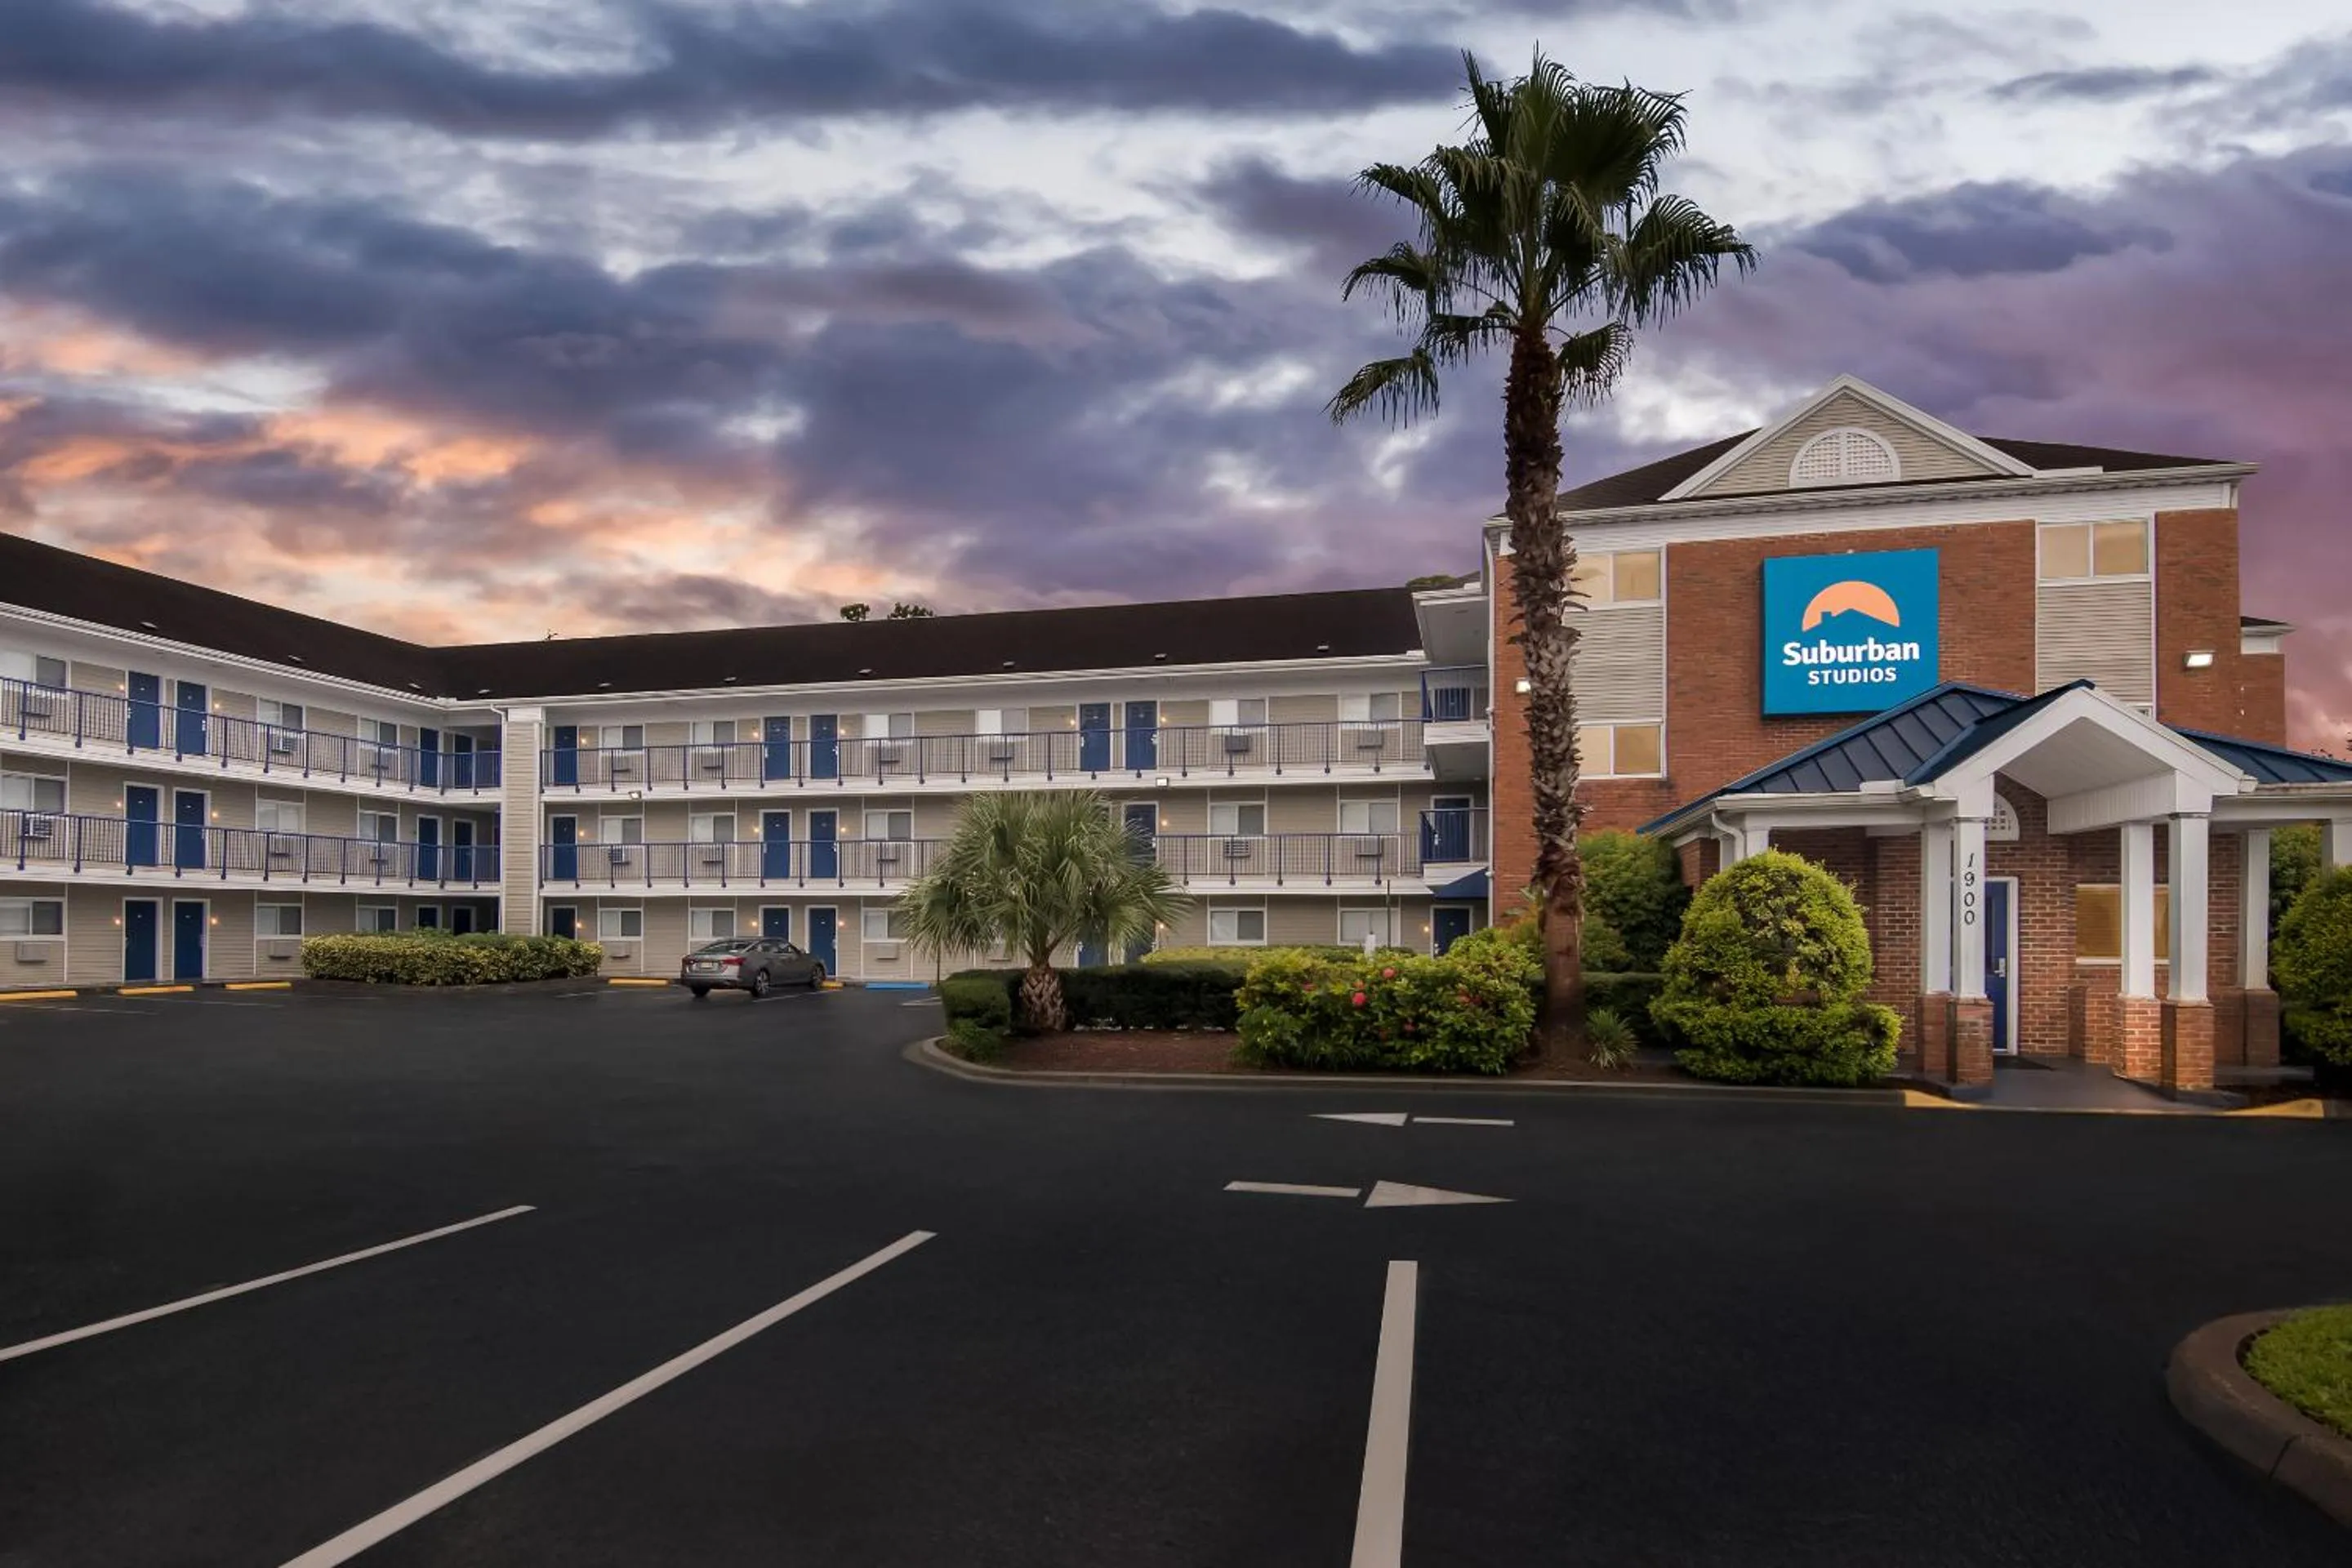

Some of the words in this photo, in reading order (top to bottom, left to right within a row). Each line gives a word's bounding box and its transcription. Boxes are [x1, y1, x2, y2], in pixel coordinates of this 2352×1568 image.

[1782, 637, 1920, 666] Suburban
[1807, 667, 1897, 685] STUDIOS
[1964, 853, 1975, 925] 1900
